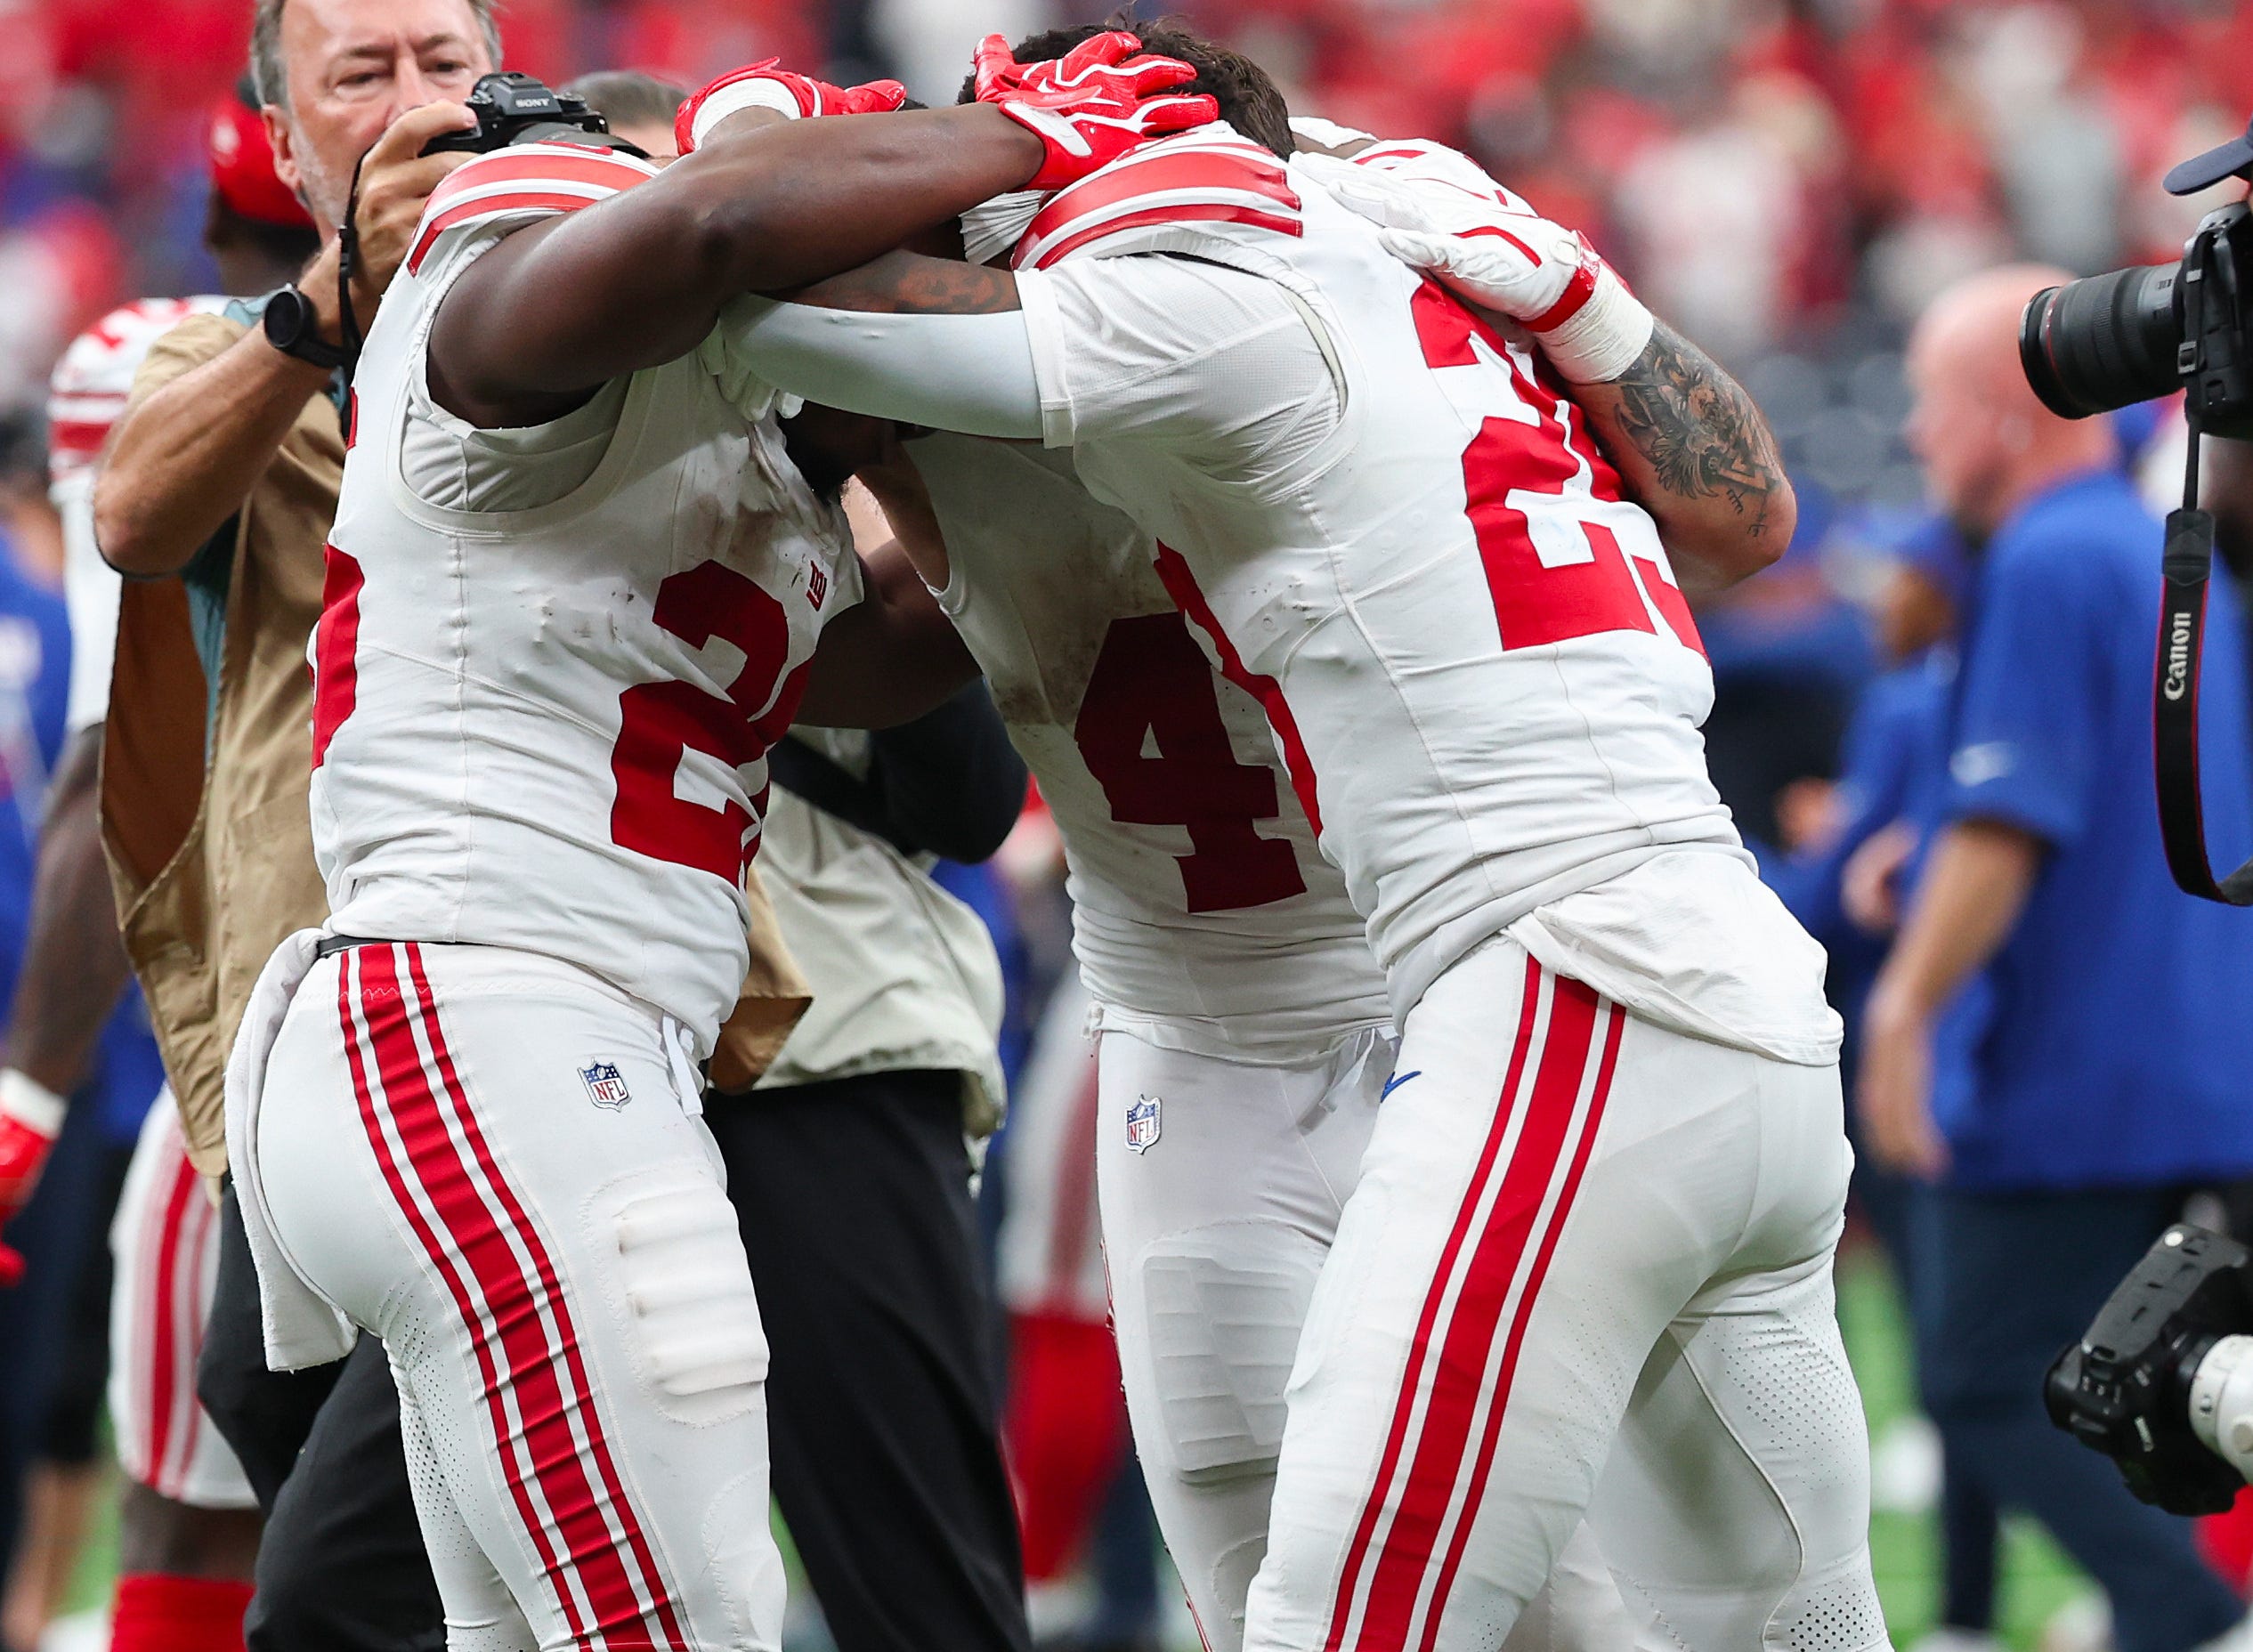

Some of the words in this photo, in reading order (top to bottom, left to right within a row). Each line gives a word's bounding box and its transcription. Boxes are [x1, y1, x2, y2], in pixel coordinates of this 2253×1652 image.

[515, 98, 550, 109] SONY
[2163, 611, 2192, 700] Canon
[592, 1080, 626, 1101] NFL
[1130, 1120, 1155, 1142] NFL
